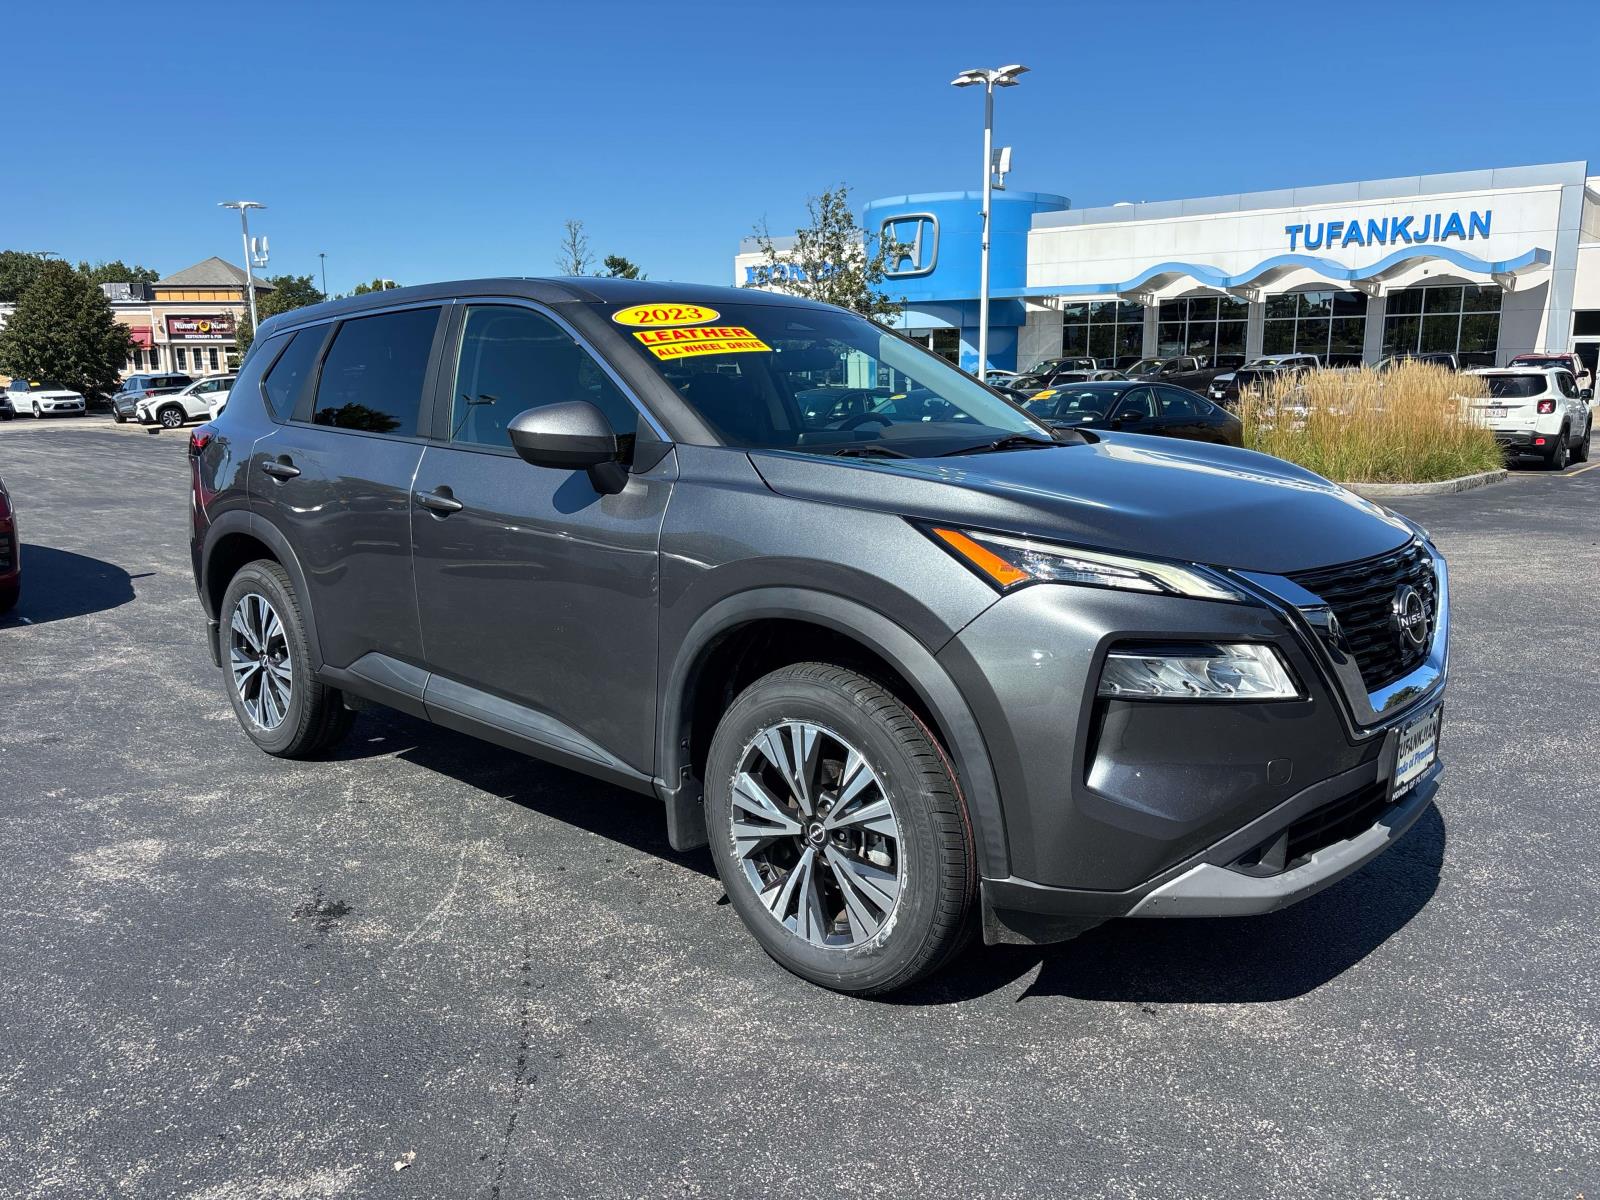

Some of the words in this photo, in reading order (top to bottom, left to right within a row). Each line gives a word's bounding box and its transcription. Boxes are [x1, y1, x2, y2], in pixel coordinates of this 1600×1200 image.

[1285, 210, 1492, 252] TUFANKJIAN
[634, 307, 703, 324] 2023
[174, 321, 197, 330] Ninety
[640, 328, 750, 344] LEATHER
[657, 348, 682, 357] ALL
[682, 343, 725, 353] WHEEL
[727, 341, 765, 350] DRIVE
[1399, 717, 1437, 759] UFANKJIAN
